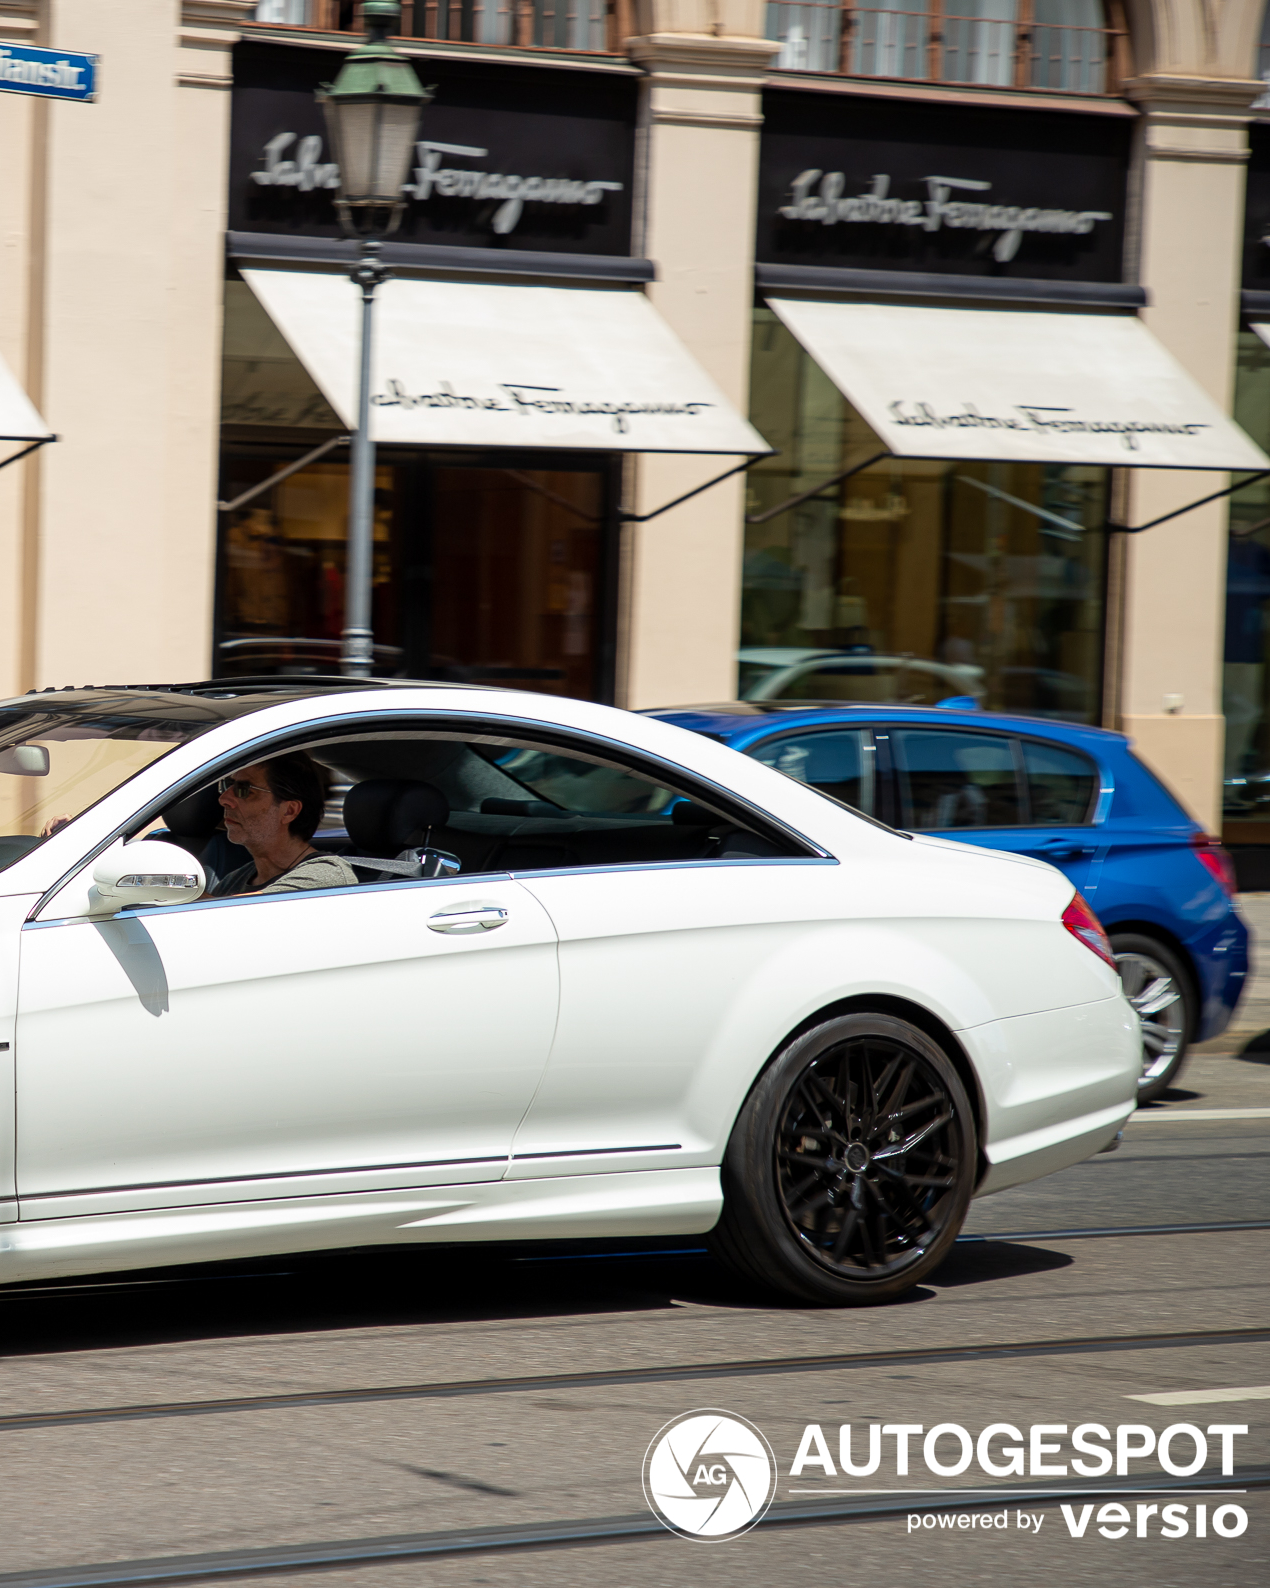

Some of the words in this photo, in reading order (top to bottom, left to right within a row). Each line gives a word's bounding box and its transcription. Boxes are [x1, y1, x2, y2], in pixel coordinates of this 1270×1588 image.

[408, 140, 624, 235] Ferragamo
[778, 168, 932, 226] Salvatore
[920, 175, 1113, 262] Ferragamo
[371, 378, 513, 411] alvatore
[496, 382, 718, 434] Ferragamo
[887, 400, 1030, 431] Salvatore
[1012, 404, 1213, 451] Ferragamo
